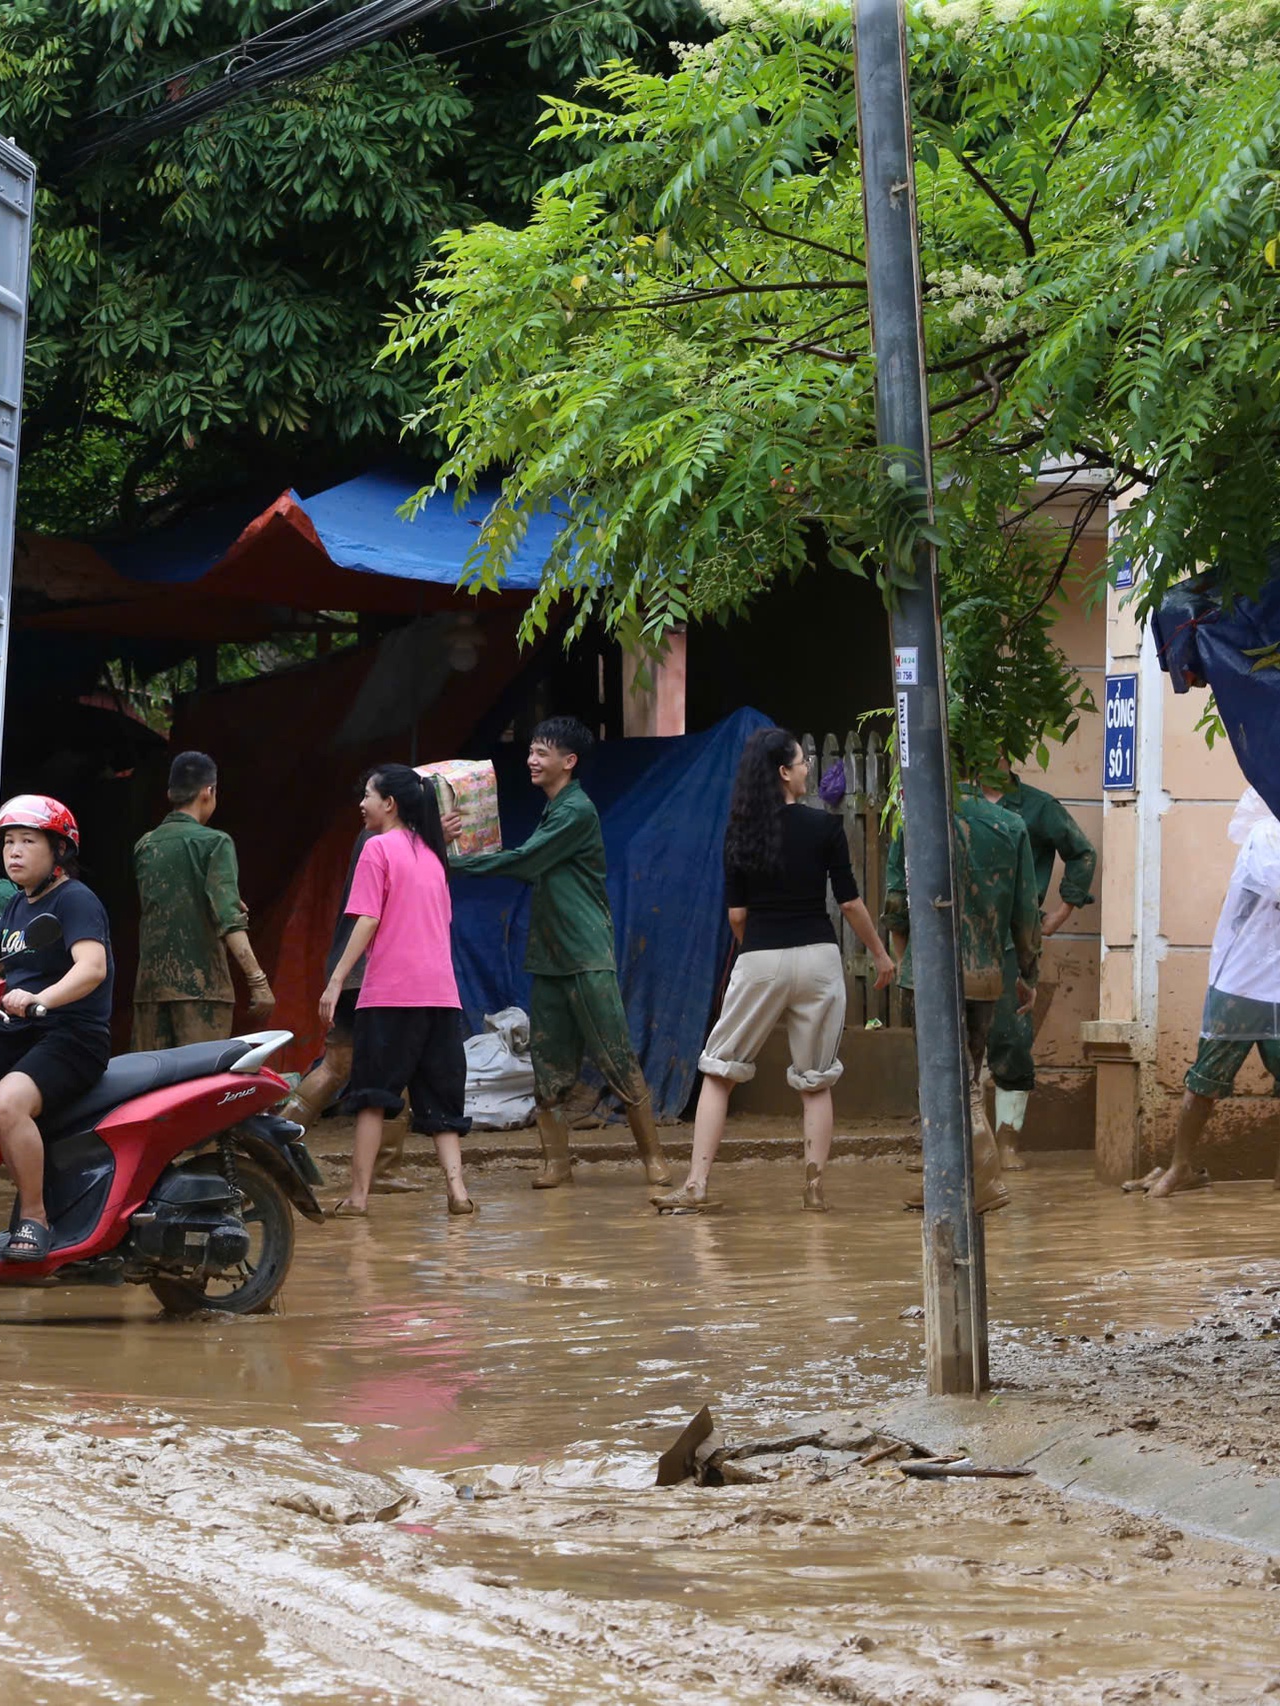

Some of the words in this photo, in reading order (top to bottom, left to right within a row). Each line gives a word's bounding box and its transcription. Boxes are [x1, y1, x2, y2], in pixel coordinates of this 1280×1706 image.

[1107, 682, 1135, 728] CỔNG
[1109, 734, 1123, 778] SỐ
[1125, 748, 1131, 776] 1
